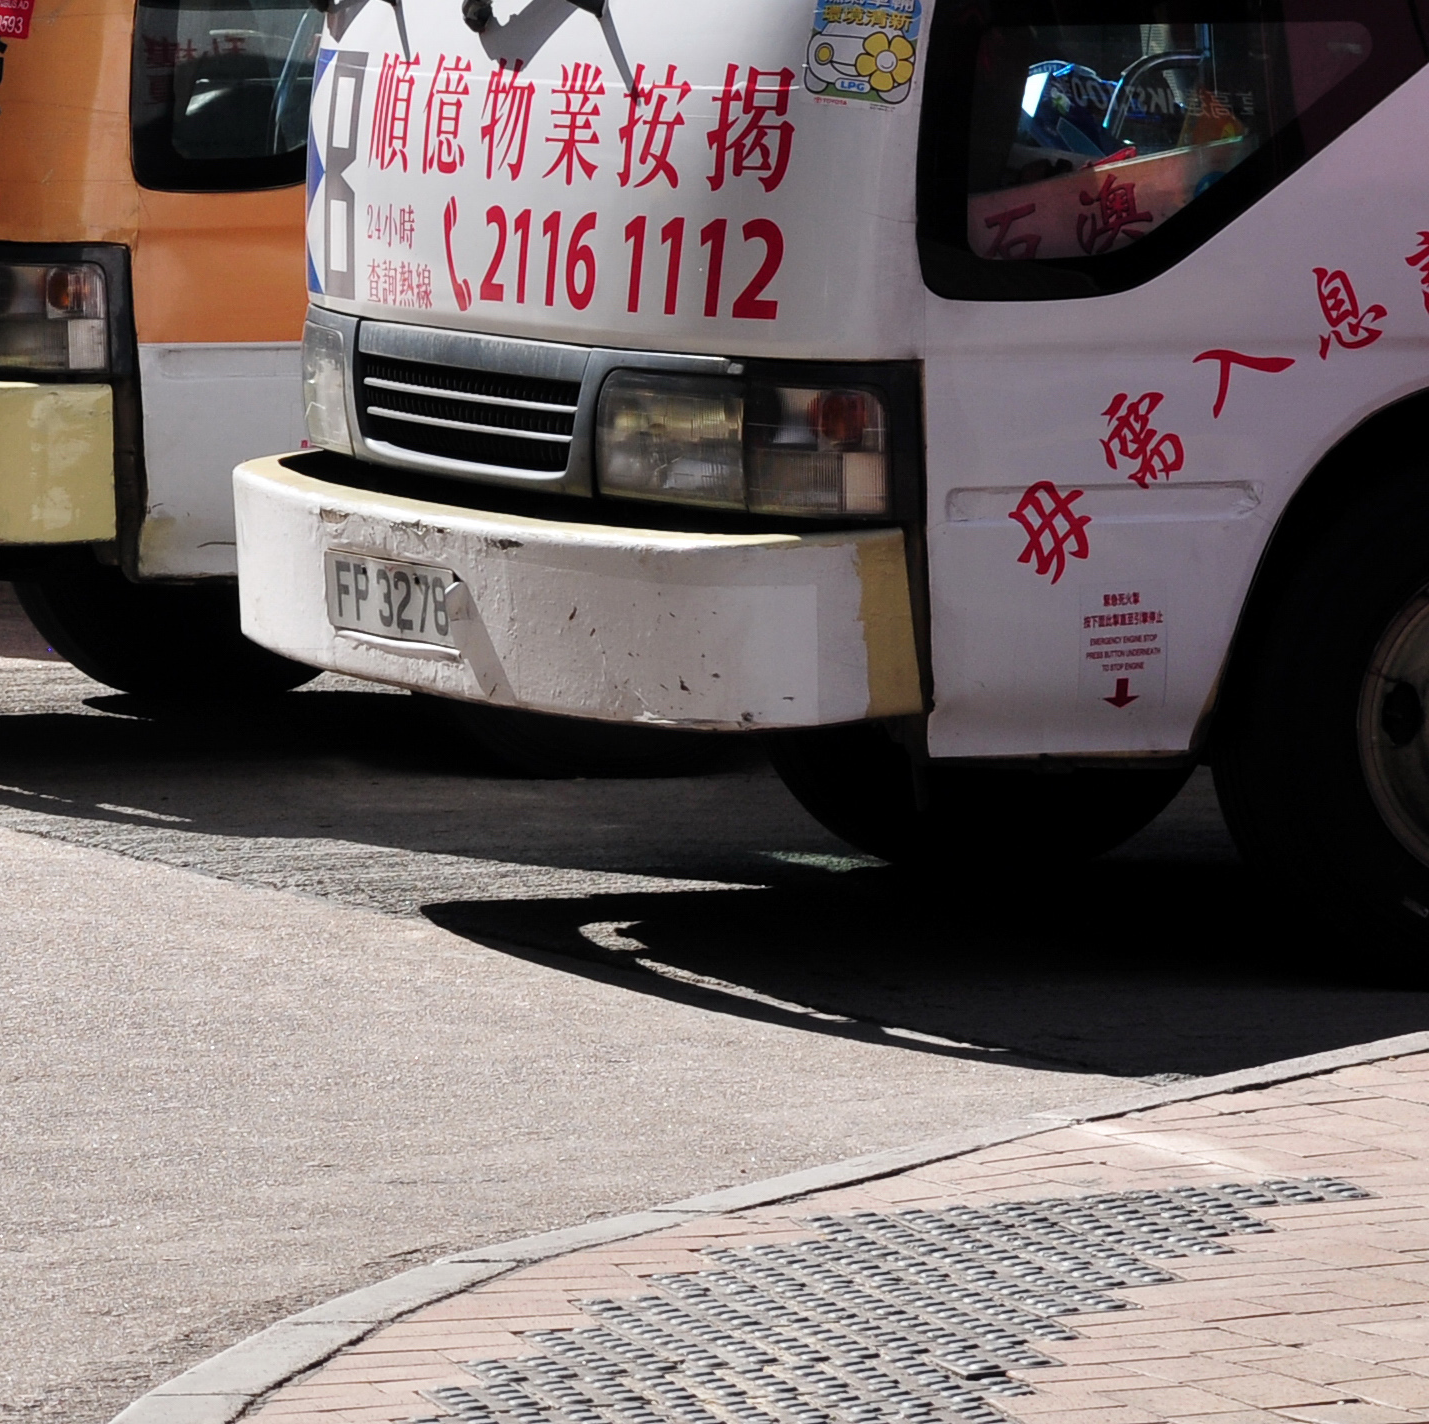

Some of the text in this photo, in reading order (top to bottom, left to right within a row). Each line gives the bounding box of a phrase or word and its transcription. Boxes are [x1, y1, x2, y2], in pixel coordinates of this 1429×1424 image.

[822, 97, 848, 106] TOYOTA
[840, 80, 865, 92] LPG
[367, 49, 798, 194] 順億物業按揭
[366, 203, 416, 249] 24小時
[478, 204, 785, 321] 2116 1112
[334, 559, 449, 636] FP 3278
